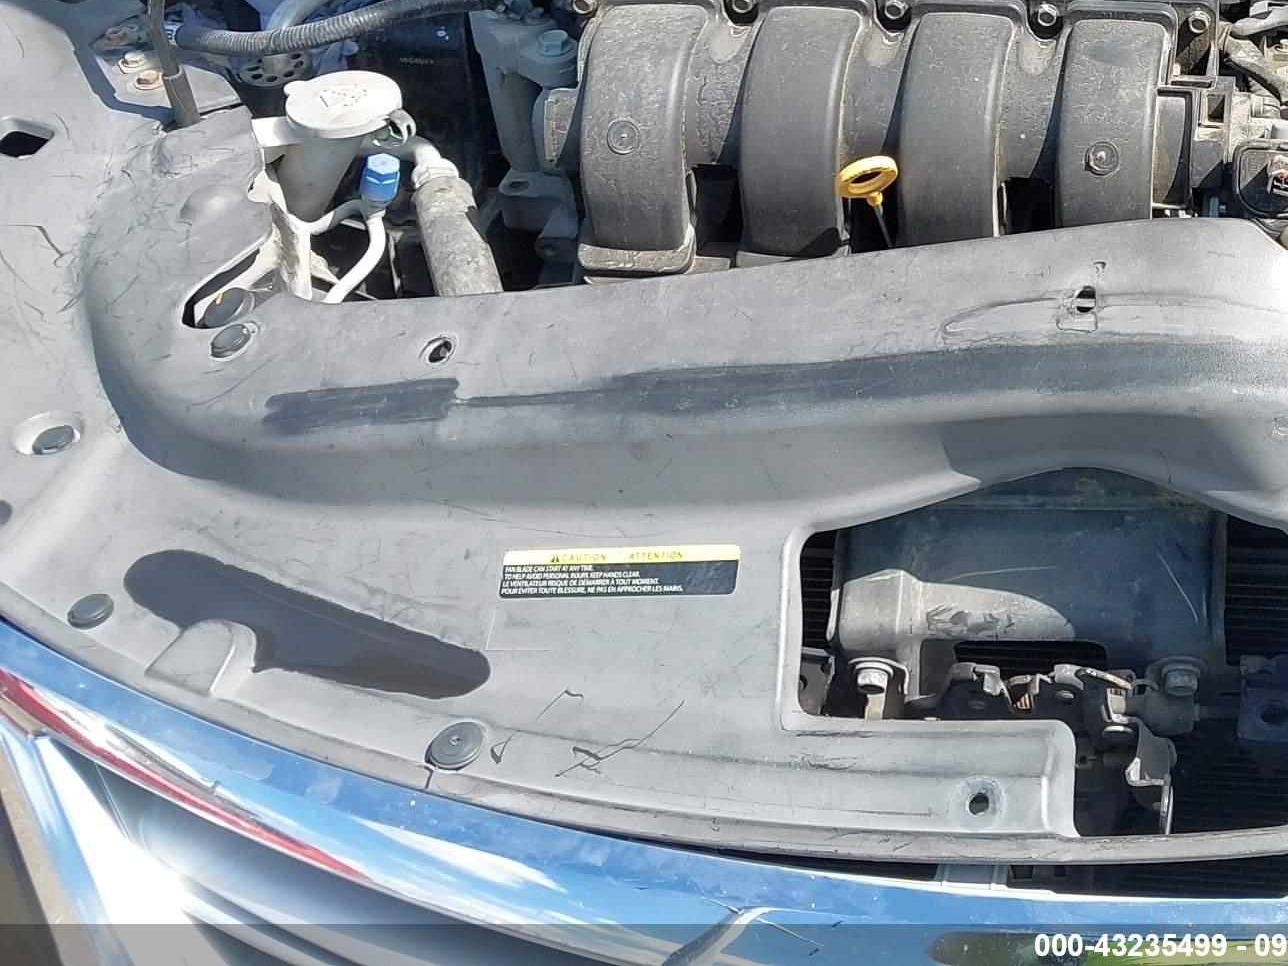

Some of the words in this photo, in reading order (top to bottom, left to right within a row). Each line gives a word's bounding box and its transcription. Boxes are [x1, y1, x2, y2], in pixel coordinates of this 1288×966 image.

[561, 553, 606, 562] CAUTION
[628, 551, 684, 561] ATTENTION
[510, 579, 547, 587] VENTILATEUR
[617, 585, 651, 593] APPROCHER
